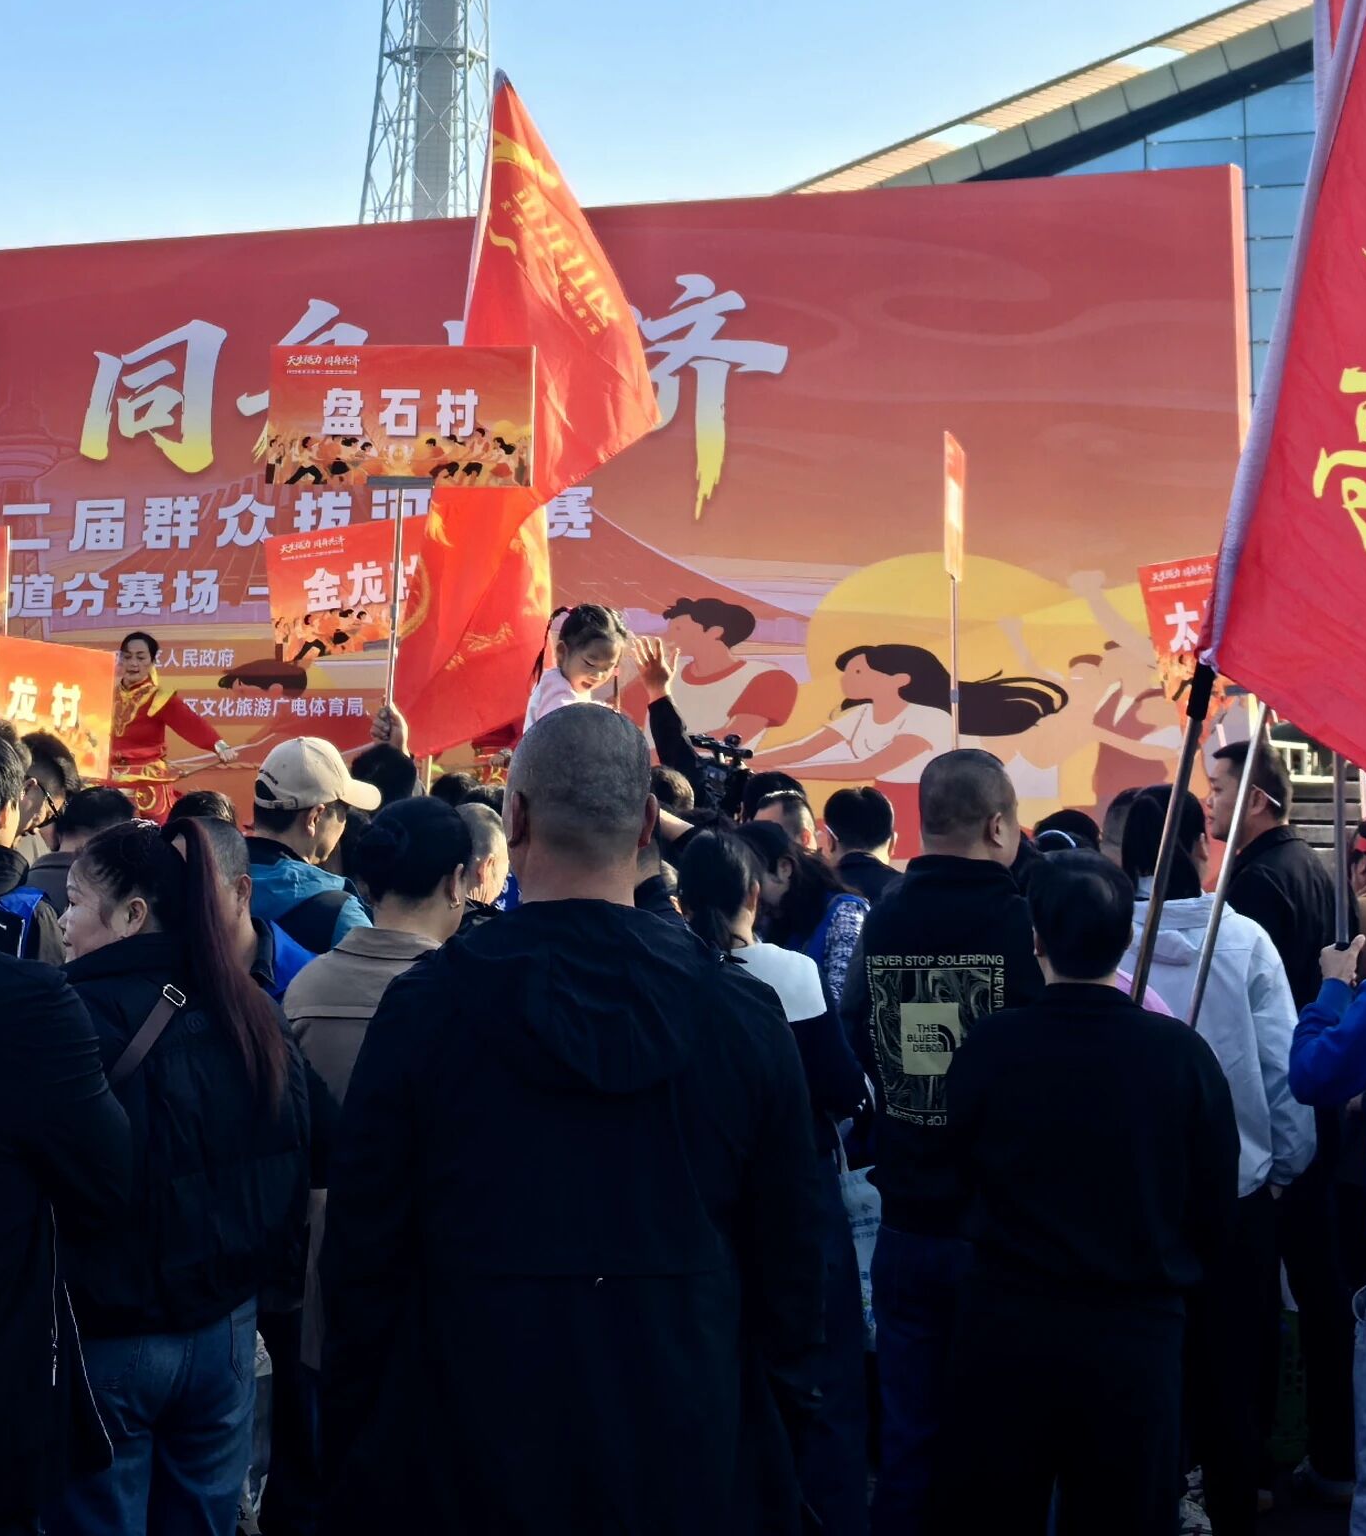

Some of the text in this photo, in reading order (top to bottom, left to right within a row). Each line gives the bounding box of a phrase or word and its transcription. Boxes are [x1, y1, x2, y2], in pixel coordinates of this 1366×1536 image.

[321, 387, 479, 437] 盘石村
[871, 955, 903, 966] NEVER
[905, 955, 935, 966] STOP
[916, 1023, 938, 1033] THE
